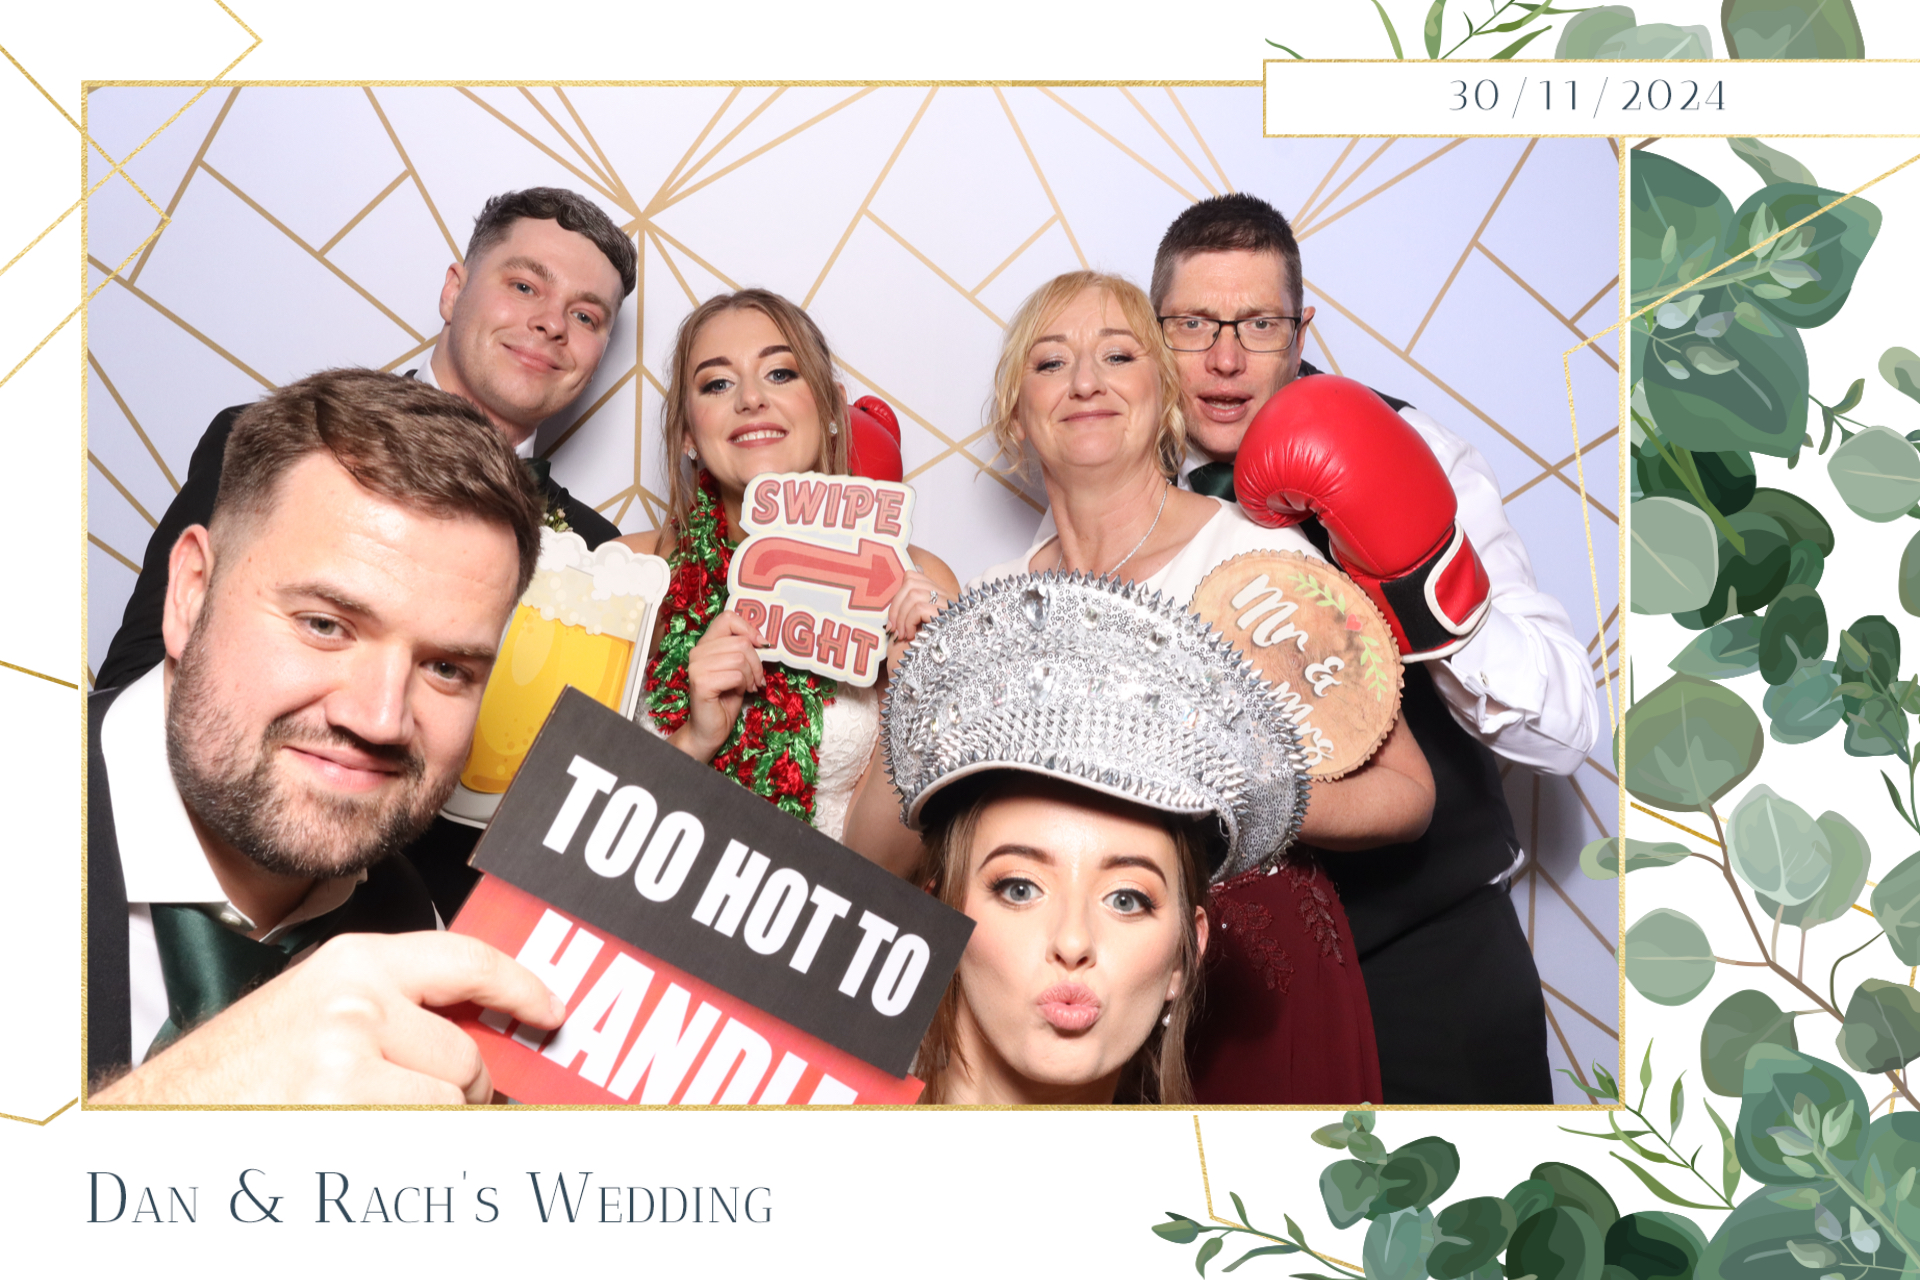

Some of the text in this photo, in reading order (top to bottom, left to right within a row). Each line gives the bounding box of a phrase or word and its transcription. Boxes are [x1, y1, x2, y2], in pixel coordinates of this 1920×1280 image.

[752, 479, 905, 537] SWIPE
[734, 598, 879, 676] RIGHT
[1231, 573, 1309, 652] Mr
[1304, 656, 1346, 698] &
[541, 754, 931, 1018] TOO HOT TO
[478, 907, 860, 1105] HAND
